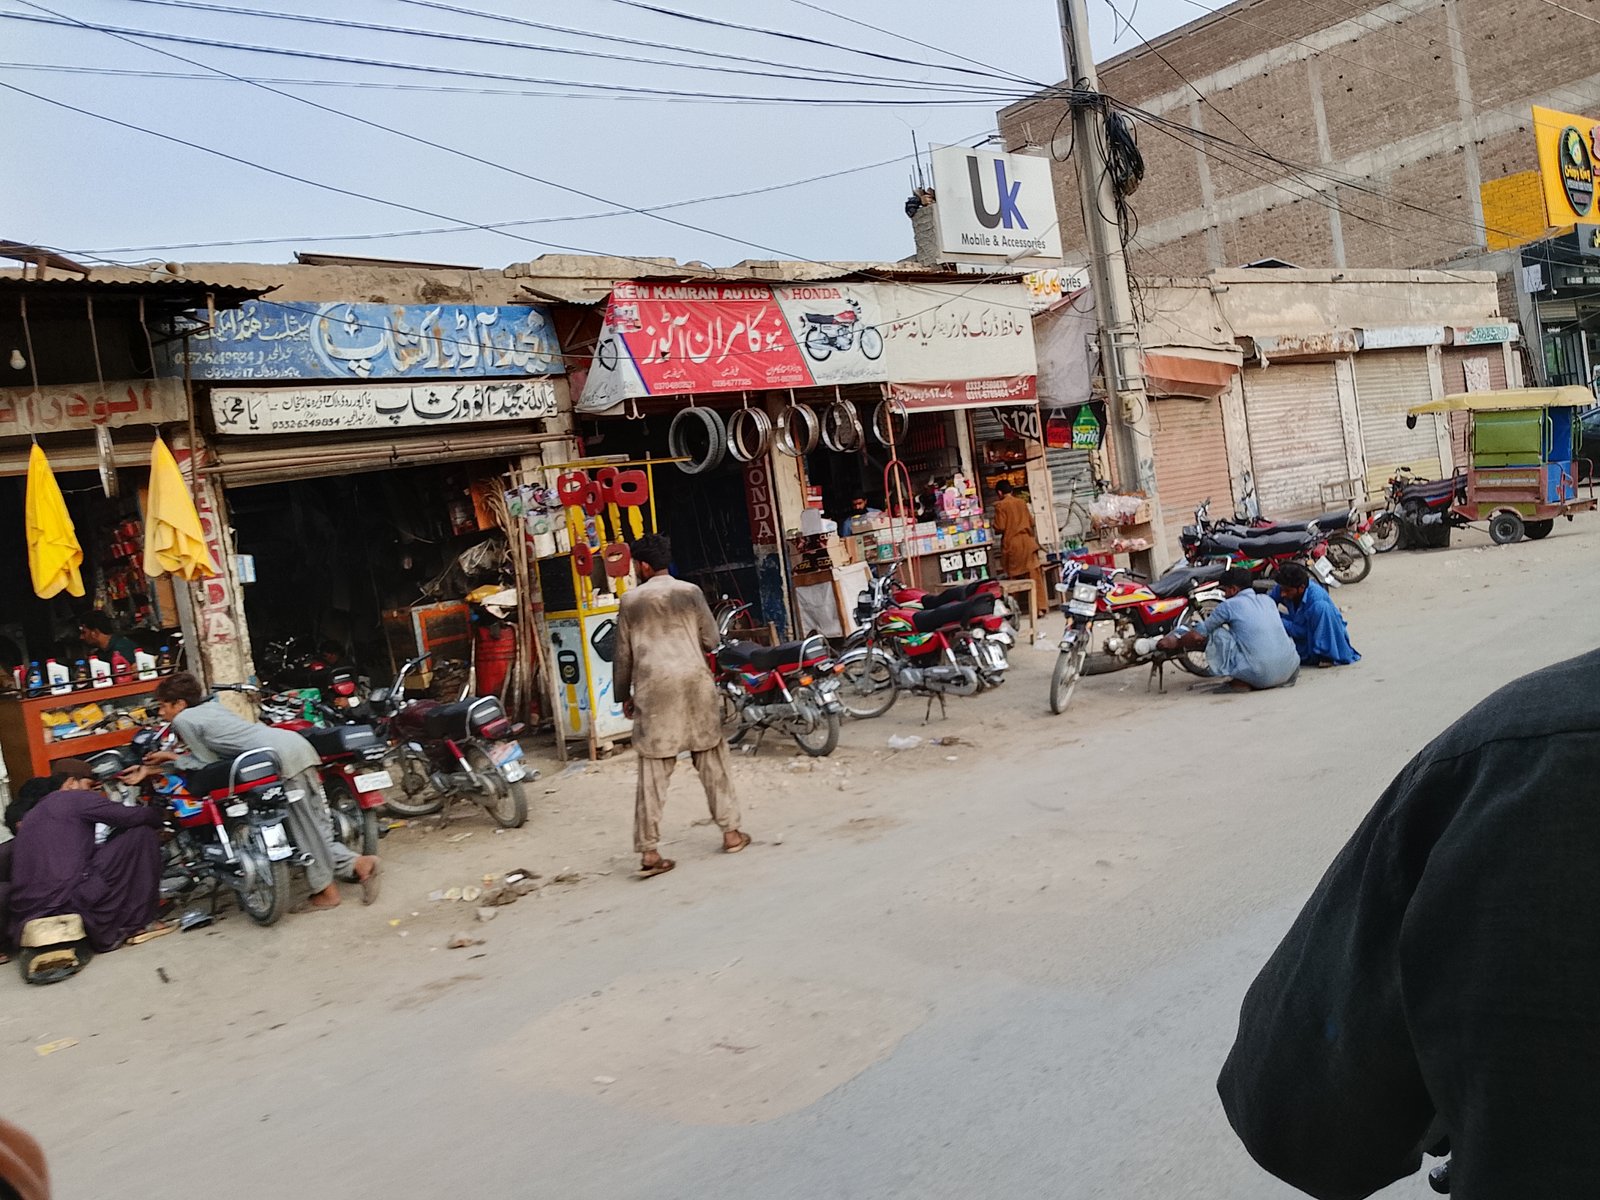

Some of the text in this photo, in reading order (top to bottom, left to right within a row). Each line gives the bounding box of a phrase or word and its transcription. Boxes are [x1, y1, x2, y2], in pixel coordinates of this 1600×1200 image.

[961, 233, 1046, 249] Mobile & Accessories
[613, 286, 770, 300] NEW KAMRAN AUTOS
[792, 287, 842, 300] HONDA
[969, 308, 999, 337] ڈرنک
[1001, 311, 1025, 337] حافظ
[686, 305, 767, 365] کامران
[765, 318, 785, 352] نیو
[242, 367, 254, 378] 17
[323, 395, 332, 403] 17
[747, 462, 774, 538] ONDA
